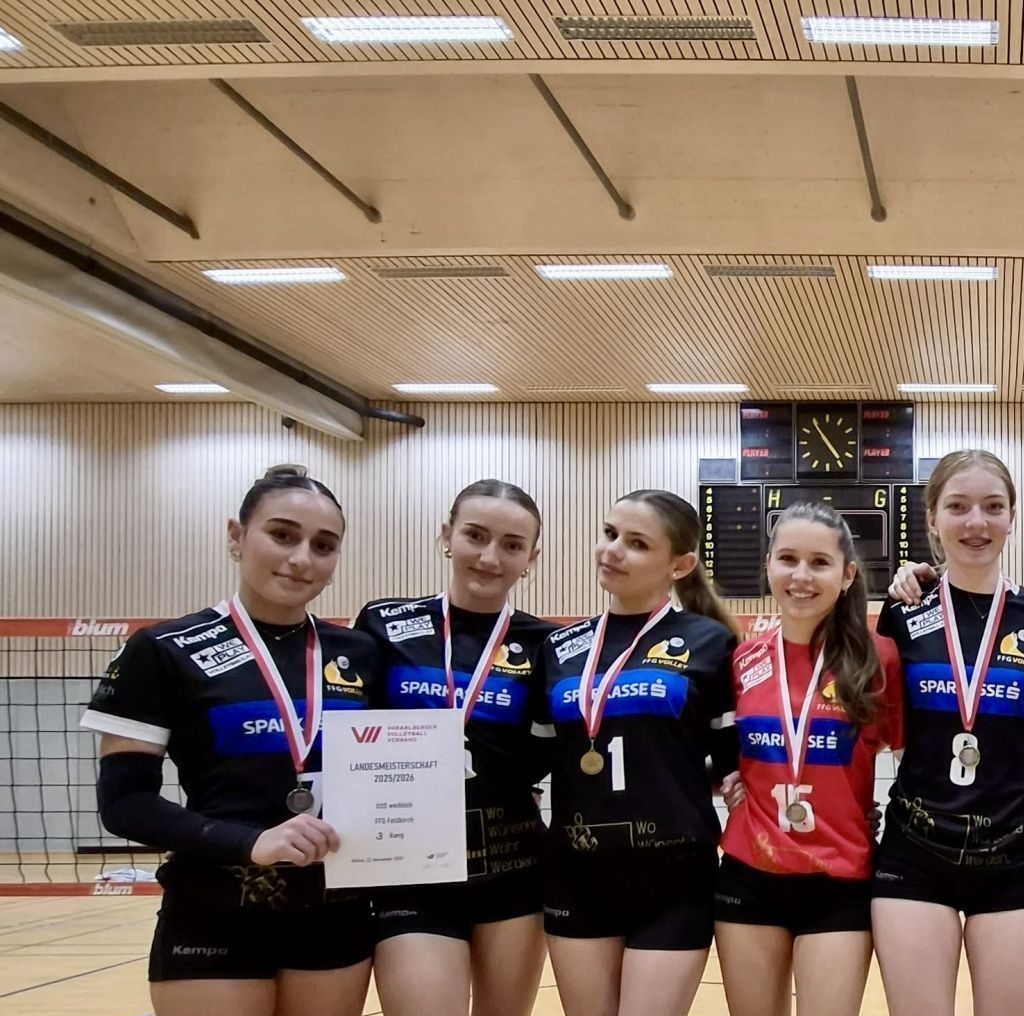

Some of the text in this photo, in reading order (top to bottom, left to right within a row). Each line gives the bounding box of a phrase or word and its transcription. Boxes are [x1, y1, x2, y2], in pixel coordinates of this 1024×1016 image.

[705, 487, 713, 495] 4
[900, 486, 907, 494] 4
[768, 489, 887, 508] H G
[706, 514, 713, 522] 7
[900, 513, 907, 521] 7
[706, 532, 713, 540] 9
[900, 531, 907, 540] 9
[704, 541, 714, 549] 10
[899, 541, 909, 549] 10
[899, 550, 909, 558] 11
[705, 560, 714, 568] 12
[71, 620, 129, 636] blum
[550, 621, 592, 644] Kempa
[173, 625, 228, 648] Kempa
[739, 644, 769, 670] Kempa
[658, 659, 689, 670] VOLLEY
[400, 681, 495, 704] SPARKASE
[919, 680, 1005, 698] SPARSSE
[748, 732, 825, 749] SPARSE
[350, 760, 437, 771] LANDESMEISTERSCHAFT
[608, 736, 626, 791] 1
[950, 733, 979, 786] 8
[374, 773, 415, 783] 2025/2026
[771, 783, 816, 832] 15
[636, 820, 656, 834] Wo
[973, 815, 992, 828] Wo
[93, 883, 133, 895] blum
